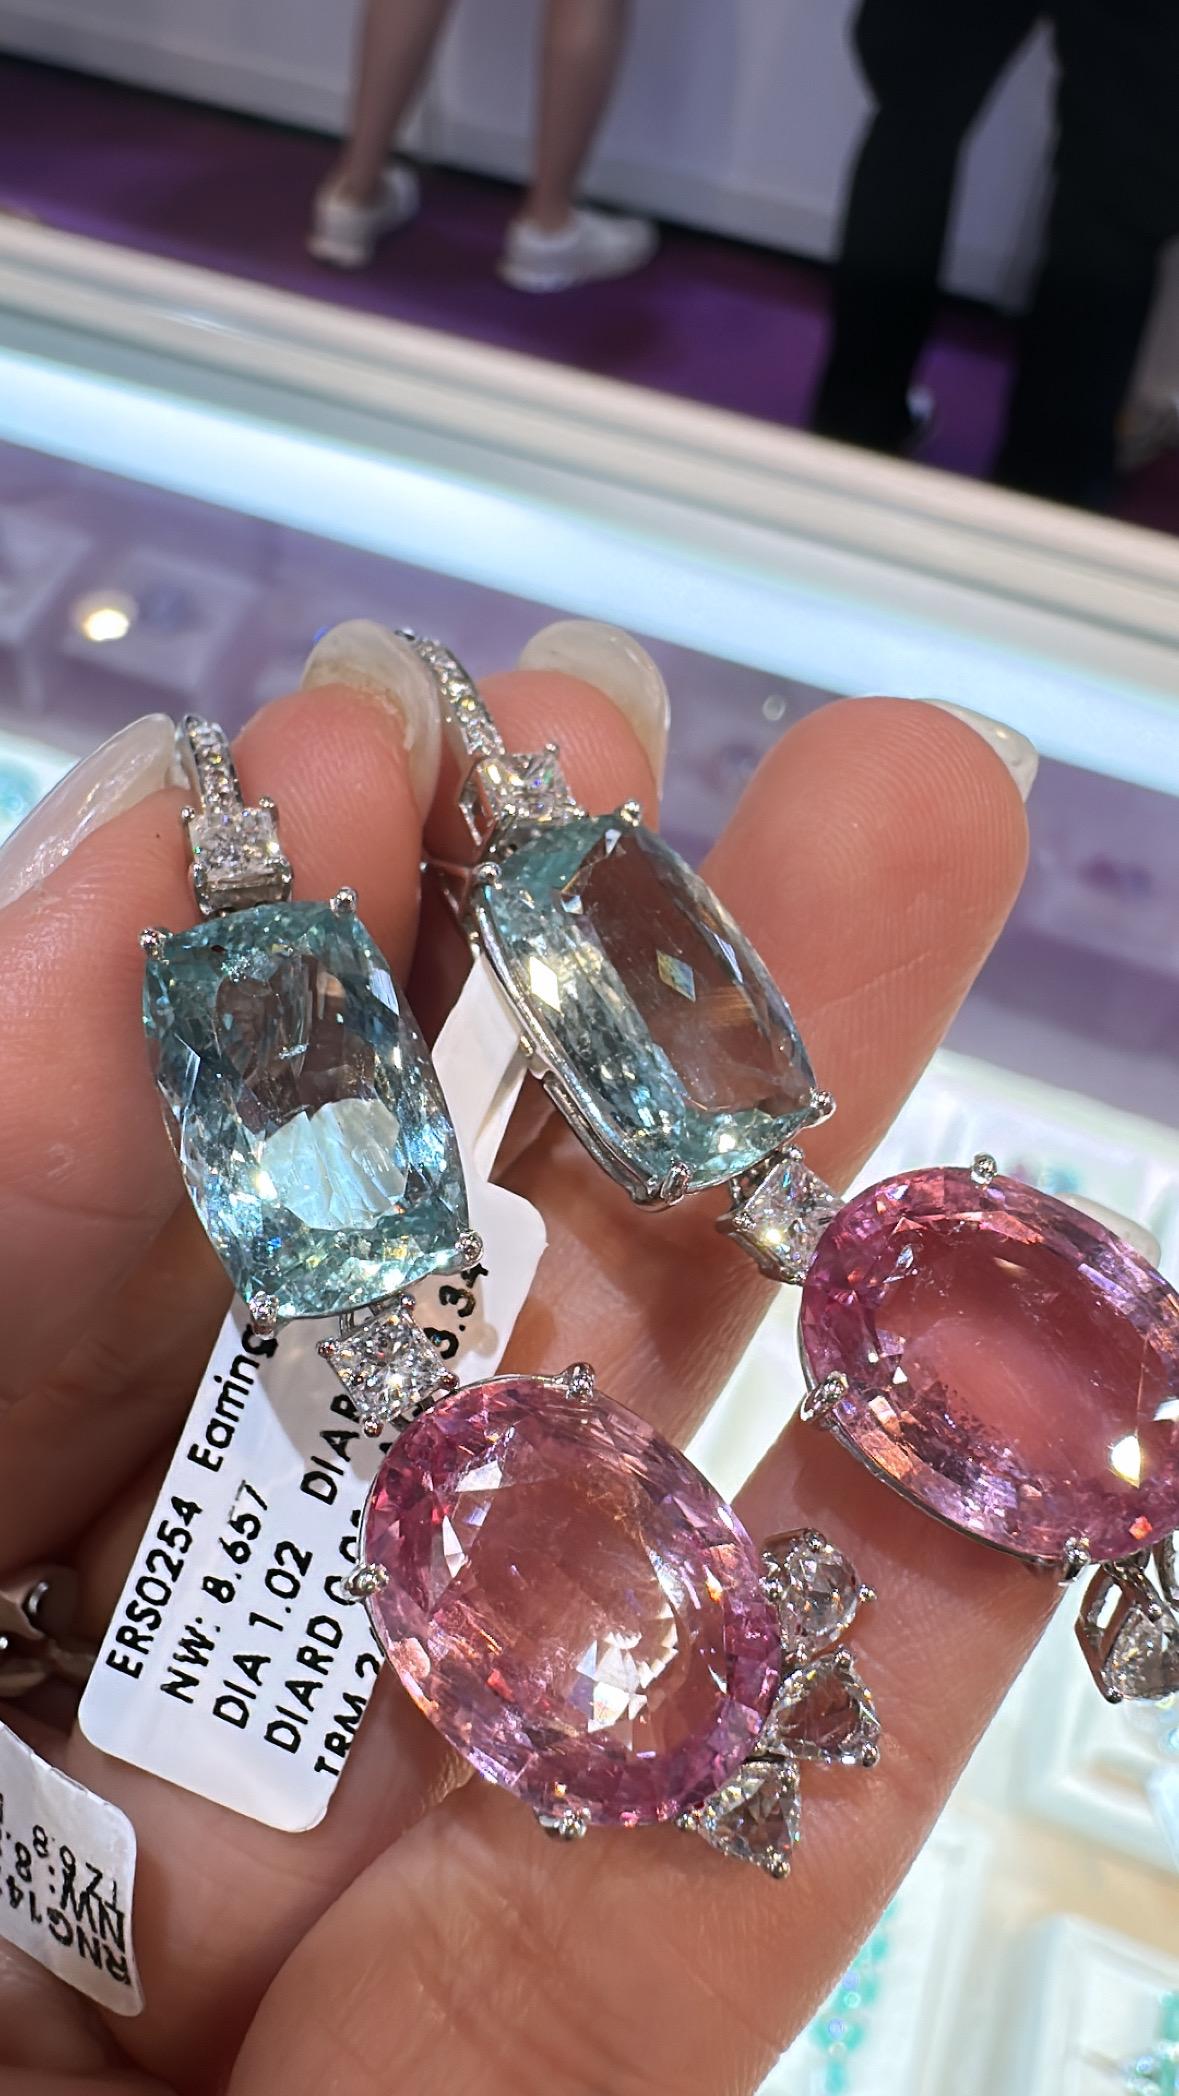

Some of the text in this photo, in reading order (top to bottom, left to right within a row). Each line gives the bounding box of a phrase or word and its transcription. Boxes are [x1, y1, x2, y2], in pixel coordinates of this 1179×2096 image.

[106, 1495, 202, 1679] ERS0254
[160, 1479, 267, 1704] NW: 8.657
[212, 1655, 271, 1729] DIA
[249, 1540, 312, 1631] 1.02
[264, 1614, 343, 1754] DIARD
